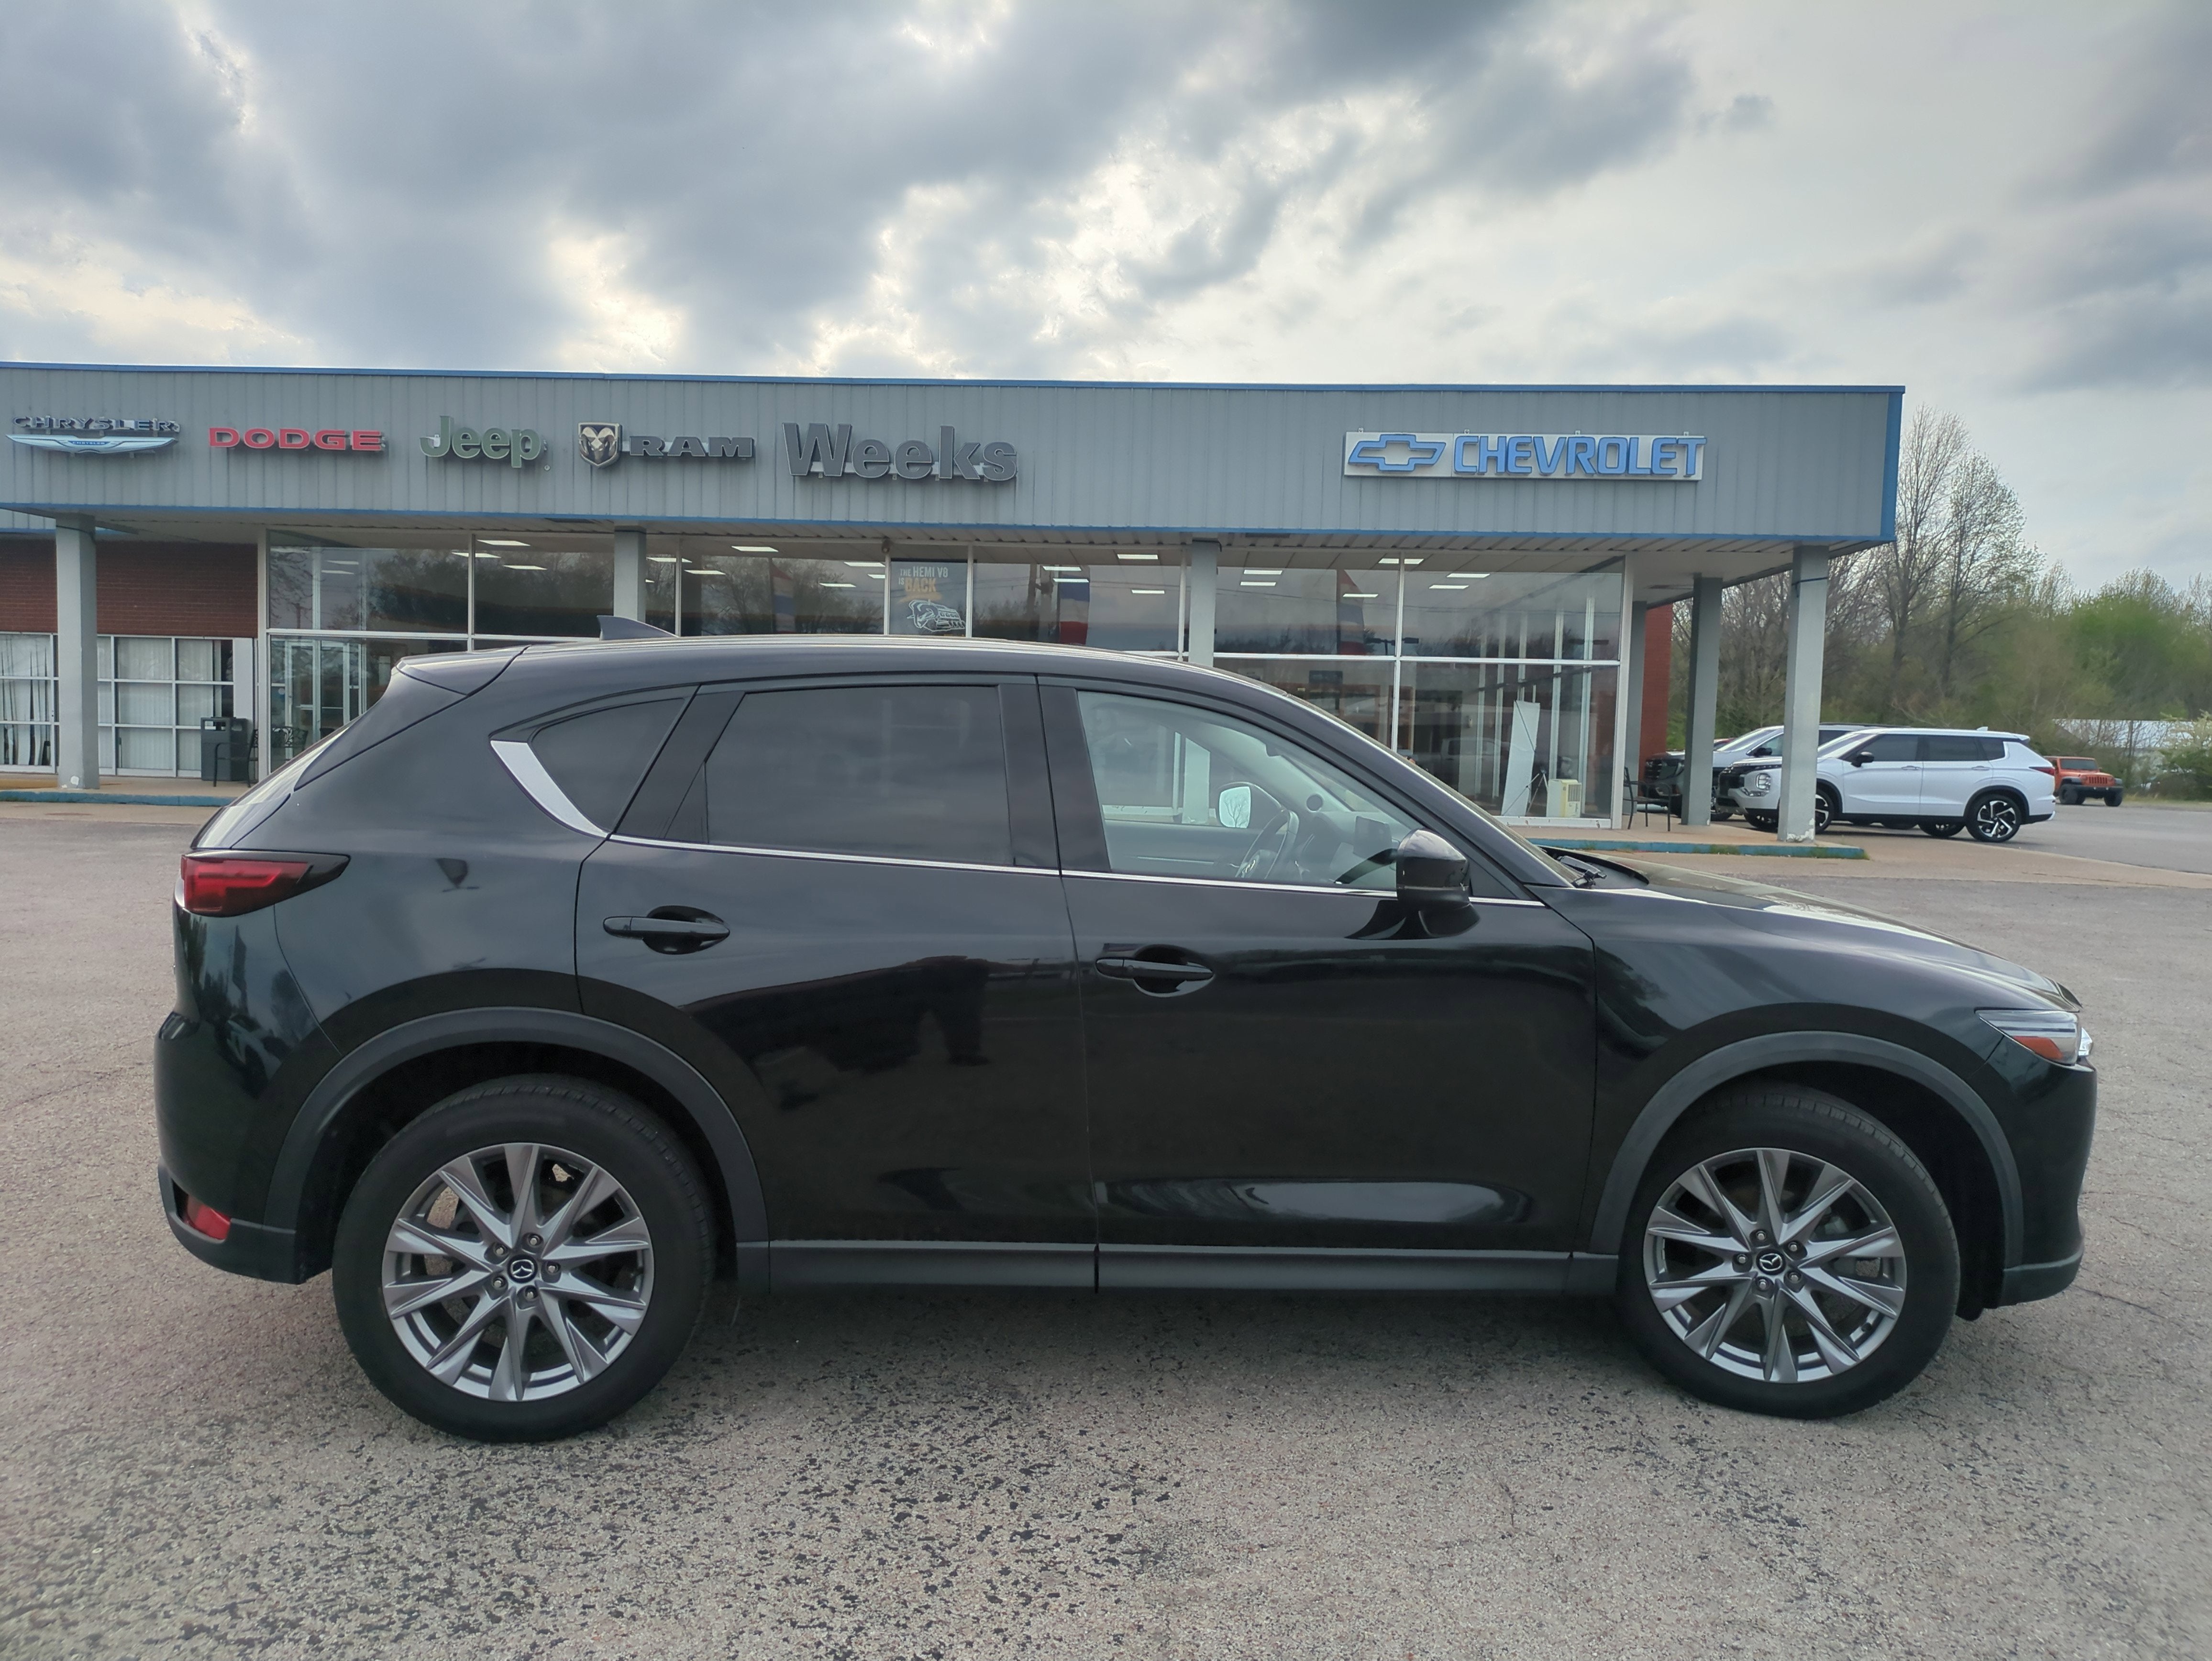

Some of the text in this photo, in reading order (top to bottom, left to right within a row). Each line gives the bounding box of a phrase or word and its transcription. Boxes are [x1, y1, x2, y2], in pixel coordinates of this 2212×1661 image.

[13, 416, 180, 432] CHRYSLER
[209, 427, 382, 451] DODGE
[420, 415, 541, 468] Jeep
[630, 436, 754, 457] RAM
[782, 422, 1017, 481] Weeks
[1453, 436, 1707, 477] CHEVROLET
[900, 566, 948, 578] THE HEMI V8
[905, 577, 936, 593] BACK
